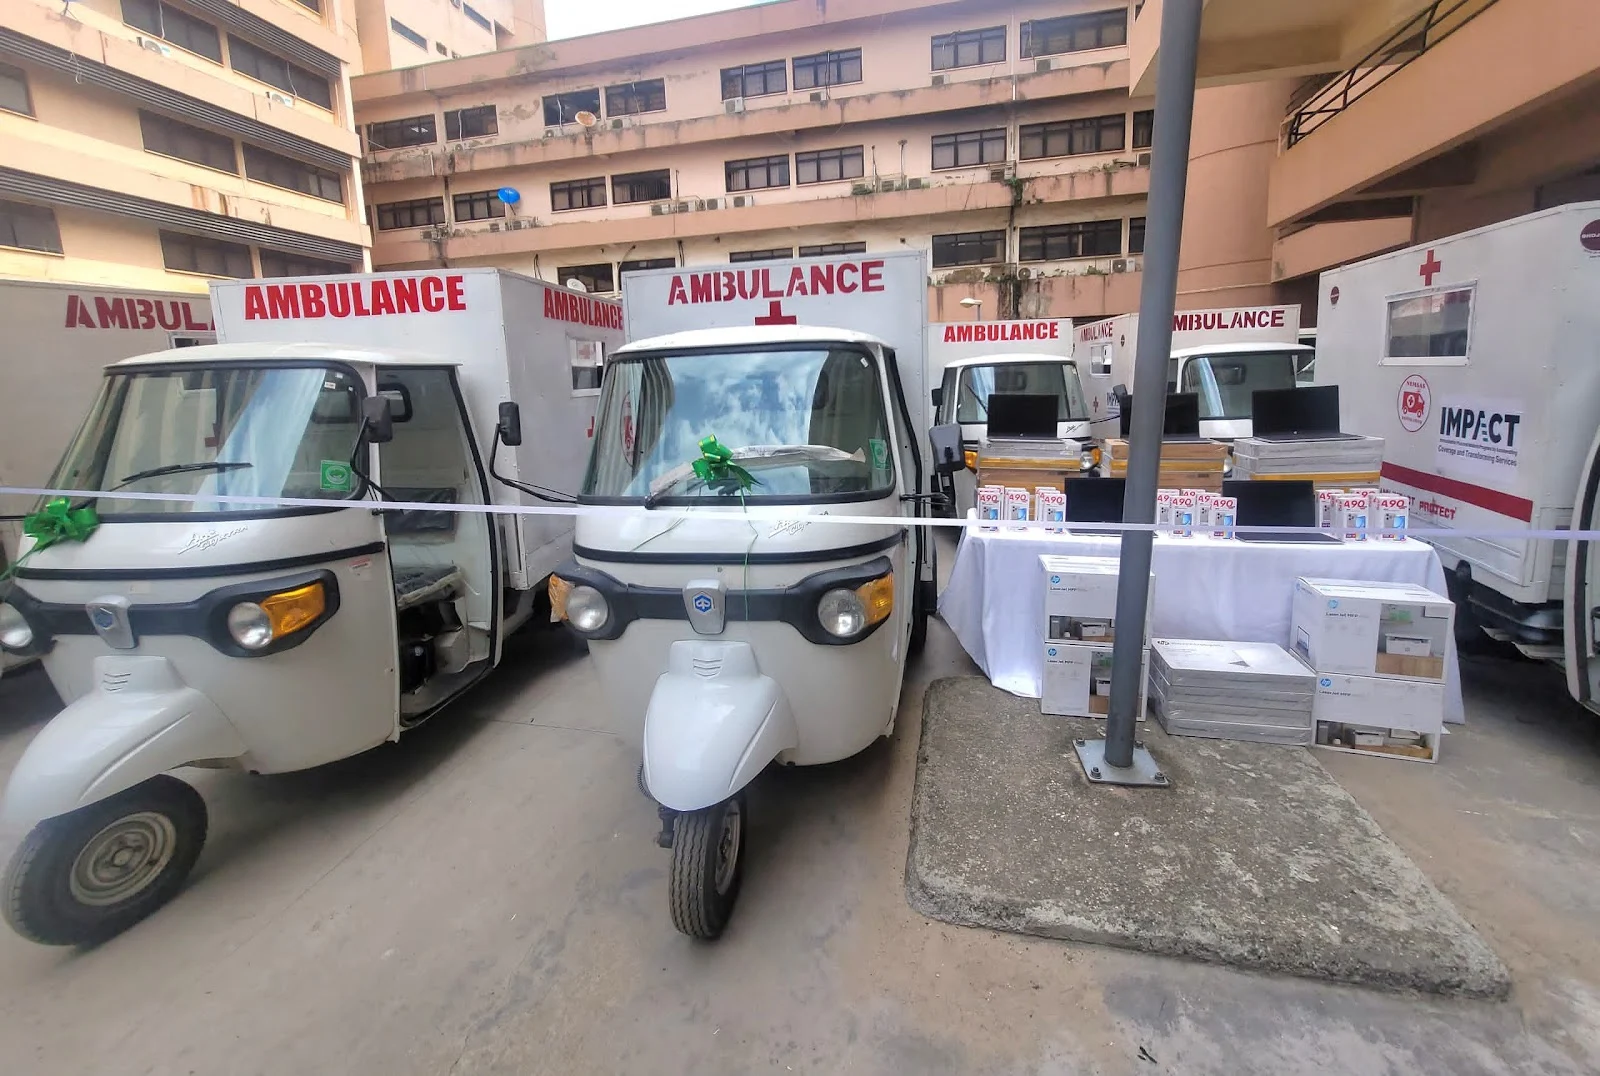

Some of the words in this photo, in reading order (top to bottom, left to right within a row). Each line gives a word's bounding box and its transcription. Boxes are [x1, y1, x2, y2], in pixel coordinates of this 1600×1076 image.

[668, 260, 885, 305] AMBULANCE
[245, 275, 466, 320] AMBULANCE
[544, 287, 624, 331] AMBULANCE
[65, 294, 216, 331] AMBUL
[1172, 310, 1285, 331] MBULANCE
[944, 322, 1059, 342] AMBULANCE
[1080, 322, 1113, 342] AMBULANCE
[1440, 406, 1520, 447] IMPACT
[1437, 445, 1456, 456] Coverage
[1456, 448, 1465, 456] and
[1465, 450, 1495, 464] Transforming
[1495, 455, 1517, 467] Services
[1320, 678, 1332, 687] hp
